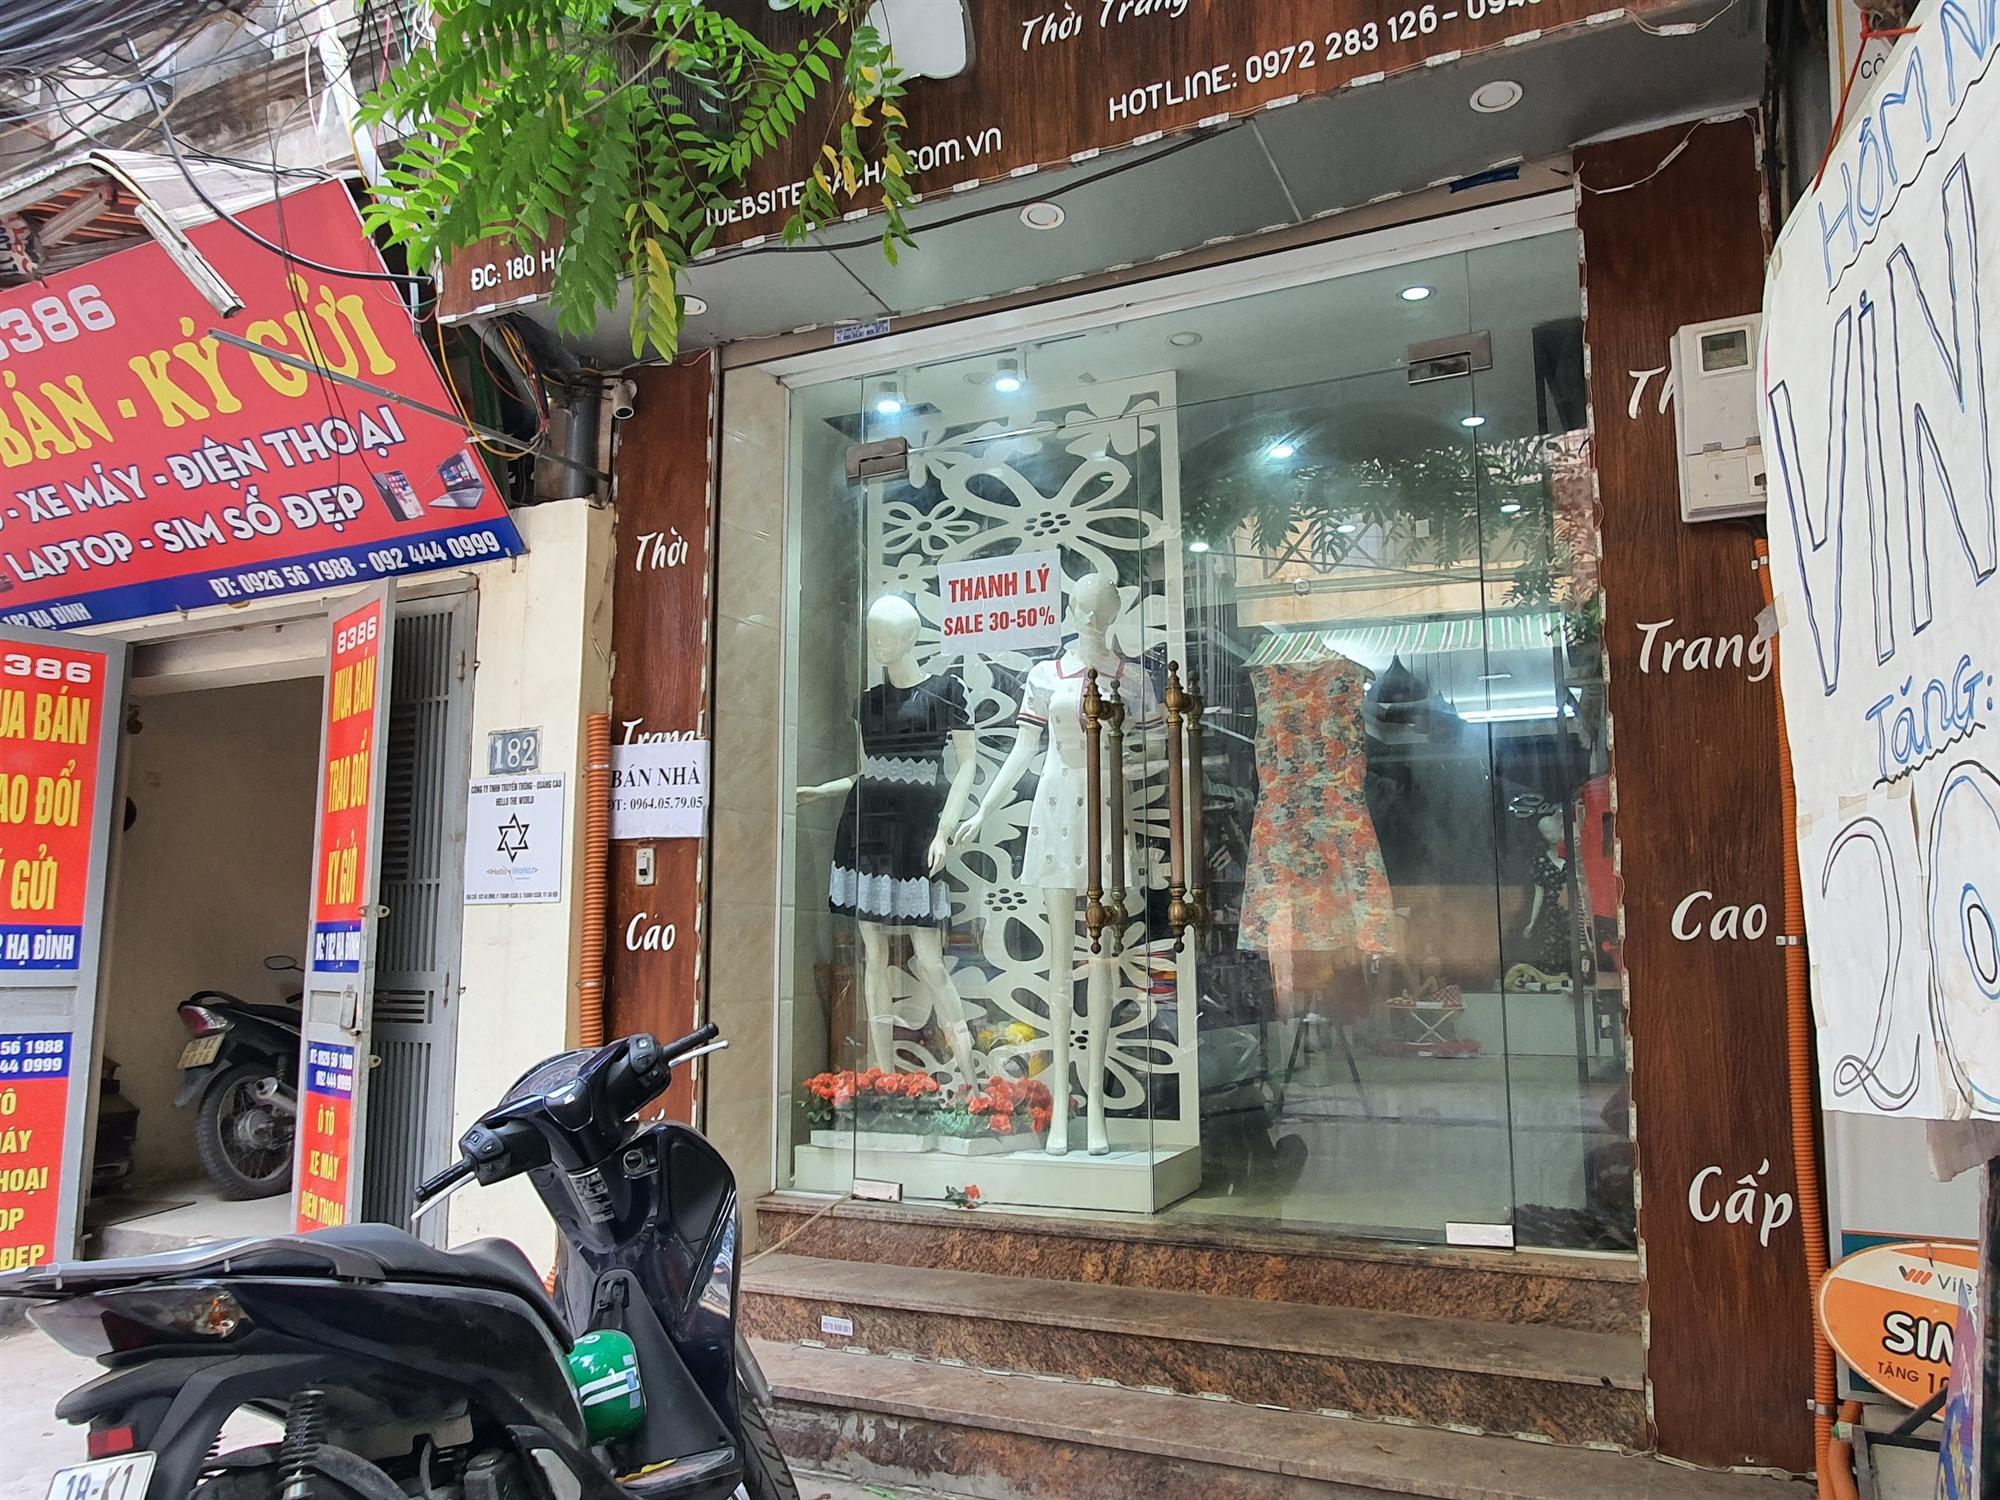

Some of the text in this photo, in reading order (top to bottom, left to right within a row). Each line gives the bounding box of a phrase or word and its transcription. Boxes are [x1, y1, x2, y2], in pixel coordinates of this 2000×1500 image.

[1021, 15, 1082, 51] Thời
[1108, 63, 1238, 123] HOTLINE:
[1244, 41, 1316, 85] 0972
[1325, 22, 1379, 62] 283
[471, 246, 566, 291] ĐC: 180 H
[0, 284, 117, 362] 386
[128, 316, 242, 428] KÝ
[16, 485, 72, 523] XE
[64, 462, 147, 512] MÁY
[166, 435, 269, 490] ĐIỆN
[262, 405, 406, 468] THOẠI
[5, 531, 134, 582] LAPTOP
[153, 512, 227, 553] SIM
[223, 484, 282, 540] SỐ
[279, 483, 365, 533] ĐẸP
[634, 527, 689, 572] Thời
[208, 577, 240, 599] ĐT:
[240, 569, 281, 594] 0926
[282, 565, 310, 588] 56
[309, 557, 357, 584] 1988
[369, 547, 408, 573] 092
[408, 541, 447, 566] 444
[448, 530, 500, 558] 0999
[948, 563, 1050, 603] THANH LÝ
[49, 603, 93, 625] ĐÌNH
[336, 615, 377, 655] 8386
[944, 605, 1055, 636] SALE 30-50%
[1635, 618, 1773, 683] Trang
[352, 647, 376, 716] BÁN
[33, 685, 91, 745] BÁN
[328, 728, 369, 814] TRAO ĐỔI
[493, 735, 536, 771] 182
[611, 760, 701, 788] BÁN NHÀ
[34, 758, 81, 828] ĐỔI
[630, 795, 704, 811] 0964.05.79.05
[10, 843, 58, 911] GỬI
[325, 838, 340, 906] KÝ
[1670, 890, 1768, 941] Cao
[5, 933, 29, 966] HẠ
[32, 928, 75, 961] ĐÌNH
[0, 1039, 65, 1055] 56 1988
[22, 1057, 63, 1073] 0999
[0, 1126, 33, 1154] ÁY
[325, 1105, 335, 1136] TÔ
[309, 1150, 339, 1181] XE MÁY
[1688, 1158, 1793, 1248] Cấp
[1877, 1360, 1919, 1382] TẶNG
